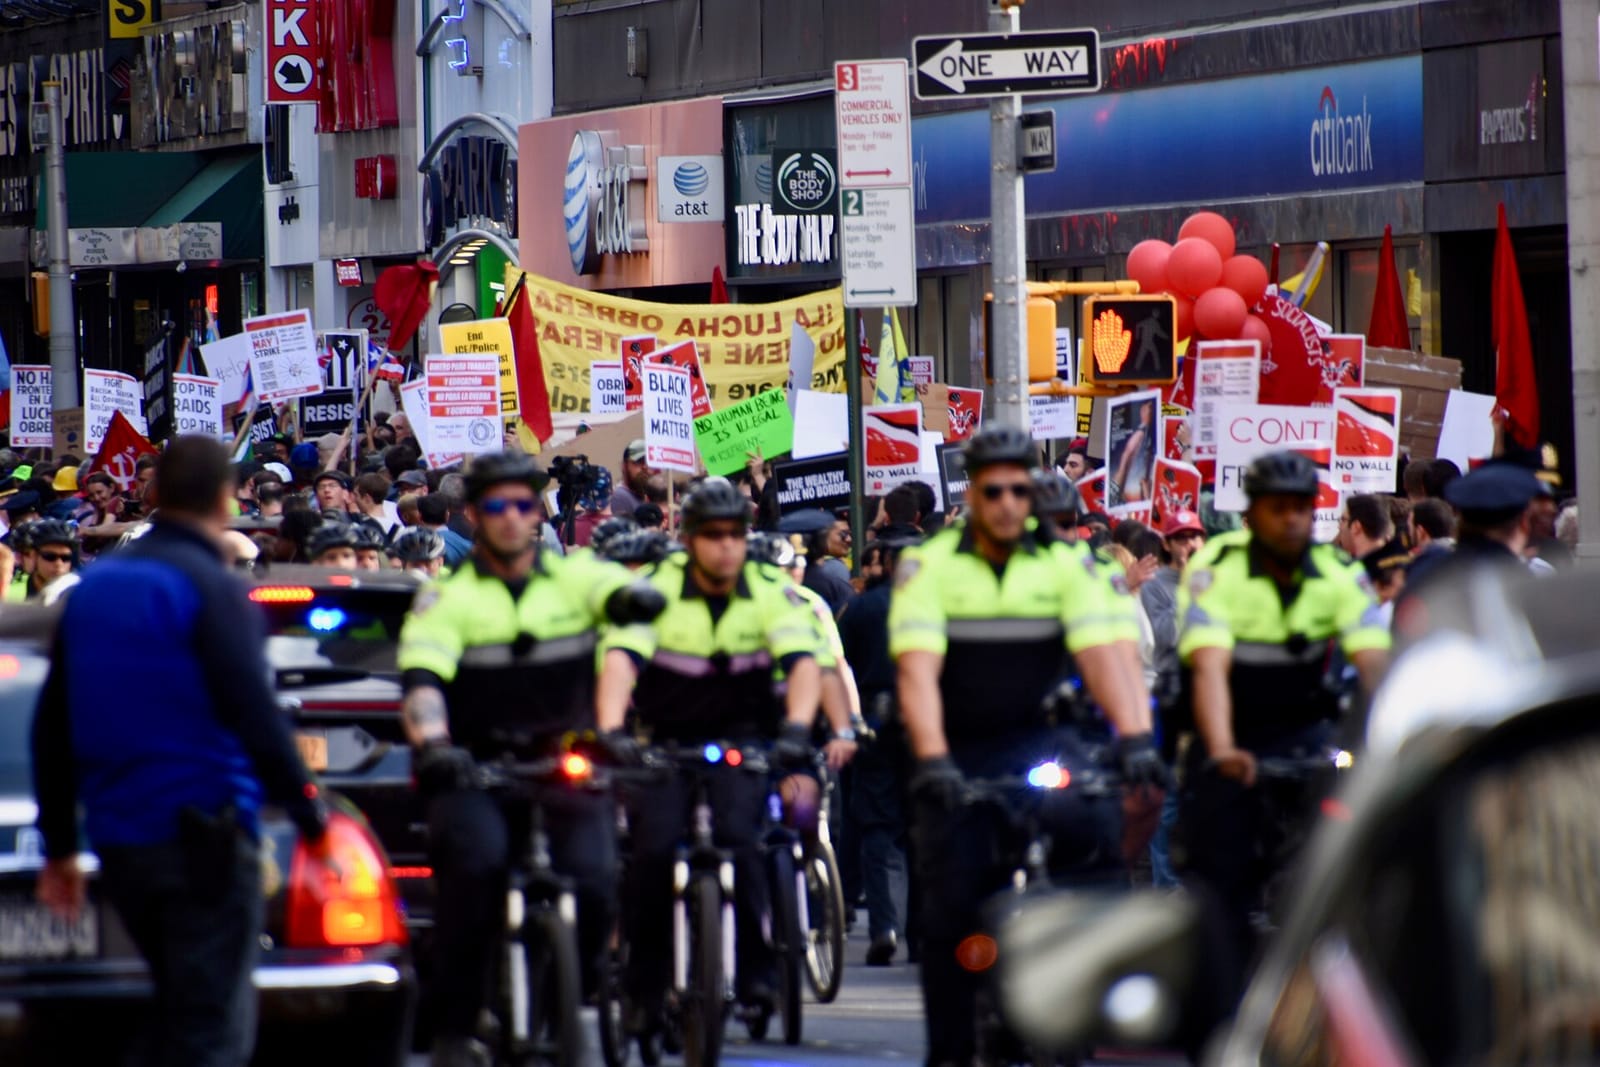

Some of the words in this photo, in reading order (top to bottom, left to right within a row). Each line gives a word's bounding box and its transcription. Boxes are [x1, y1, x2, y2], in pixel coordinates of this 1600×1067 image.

[940, 54, 993, 78] ONE
[1024, 49, 1080, 74] WAY
[841, 65, 854, 90] 3
[841, 100, 894, 112] COMMERCIAL
[841, 114, 880, 125] VEHICLES
[882, 113, 903, 124] ONLY
[1030, 129, 1050, 153] WAY
[1310, 95, 1374, 177] citibank
[796, 170, 817, 180] THE
[789, 179, 826, 191] BODY
[791, 190, 824, 201] SHOP
[847, 191, 860, 215] 2
[675, 201, 709, 216] at&t
[734, 203, 761, 265] THE
[467, 331, 484, 342] End
[1271, 297, 1324, 367] SOCIALISTS
[253, 338, 273, 350] MAY
[455, 342, 500, 354] ICE/Police
[17, 371, 36, 385] NO
[648, 372, 687, 397] BLACK
[17, 385, 52, 395] FRONTE
[174, 382, 196, 394] TOP
[198, 384, 216, 398] THE
[29, 395, 41, 405] EN
[173, 398, 212, 415] RAIDS
[657, 397, 684, 417] LIVES
[22, 407, 52, 420] LUCH
[305, 402, 355, 422] RESIS
[695, 419, 712, 435] NO
[716, 403, 753, 426] HUMAN
[754, 390, 785, 412] BEING
[20, 421, 52, 433] OBRE
[176, 417, 197, 430] TOP
[200, 420, 217, 433] THE
[651, 418, 690, 441] MATTER
[713, 430, 730, 444] IS
[736, 409, 781, 433] ILLEGAL
[867, 469, 884, 478] NO
[889, 467, 919, 477] WALL
[1335, 460, 1354, 471] NO
[1360, 461, 1392, 471] WALL
[785, 477, 804, 490] THE
[805, 470, 845, 486] WEALTHY
[777, 489, 801, 504] HAVE
[802, 487, 816, 499] NO
